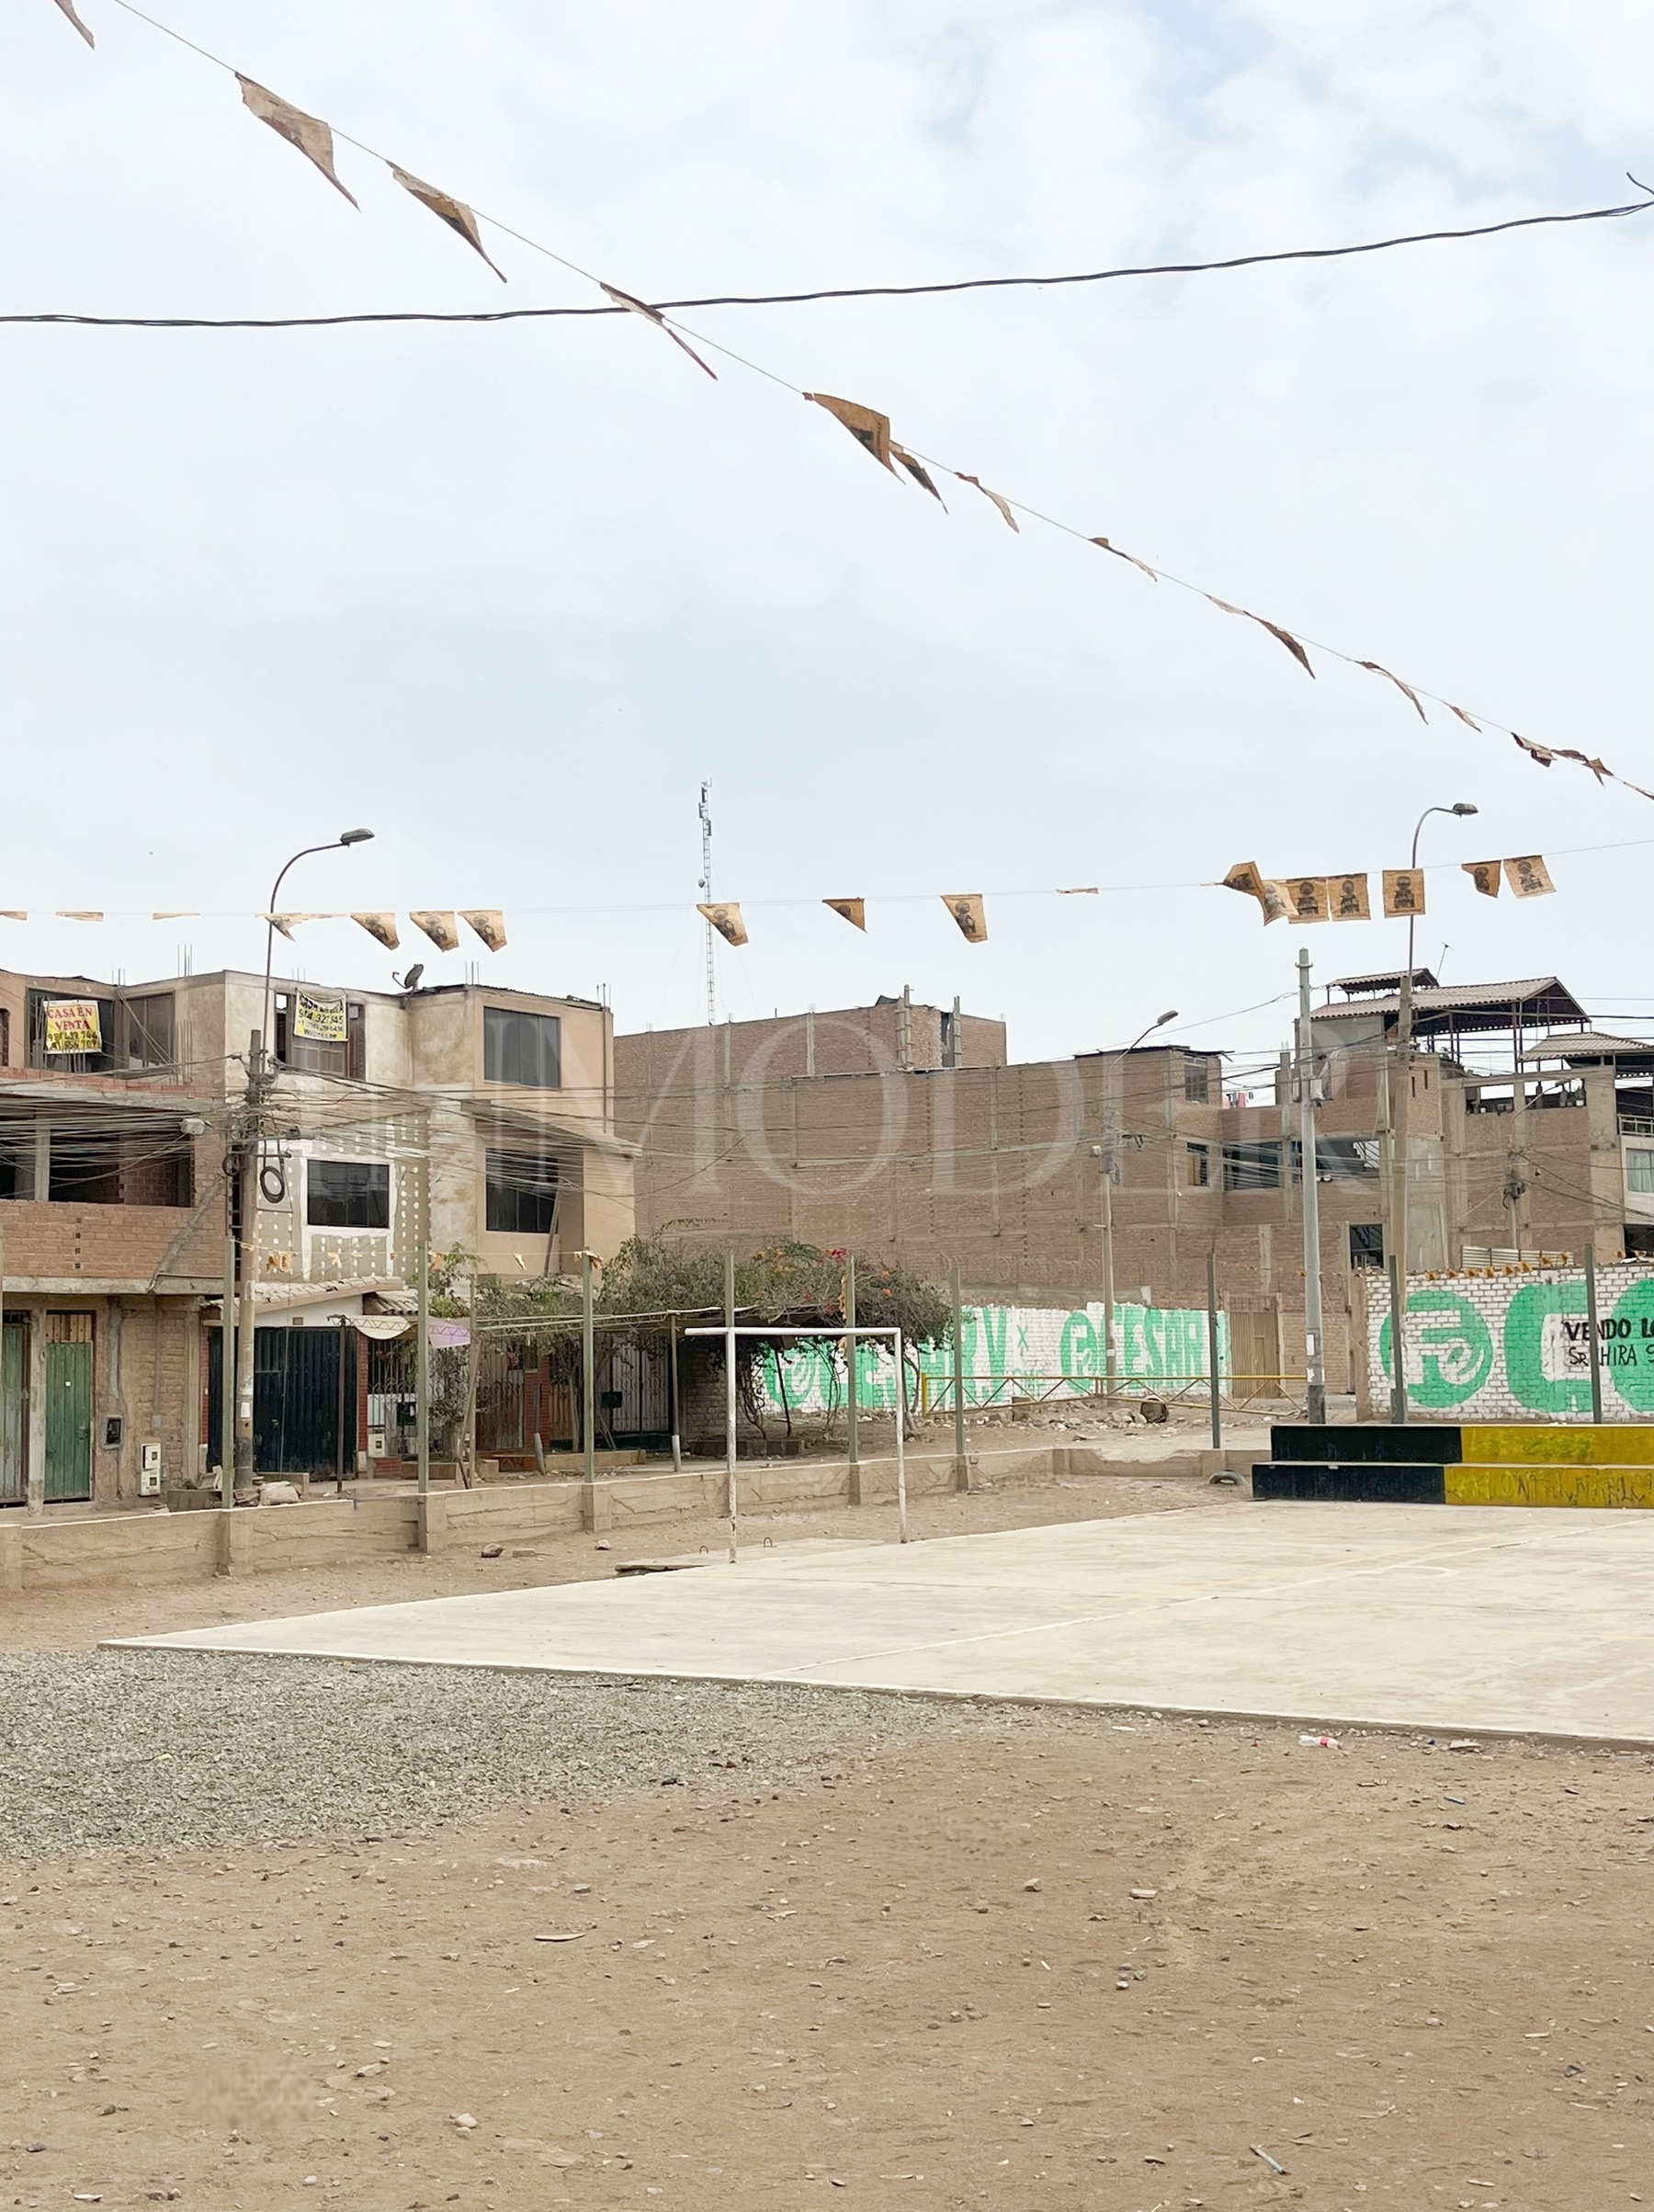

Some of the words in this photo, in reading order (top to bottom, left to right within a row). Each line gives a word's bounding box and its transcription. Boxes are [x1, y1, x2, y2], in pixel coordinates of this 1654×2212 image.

[47, 1008, 75, 1019] CASA
[77, 1006, 92, 1017] EN
[55, 1020, 90, 1030] VENTA
[1561, 1318, 1632, 1341] VENDO
